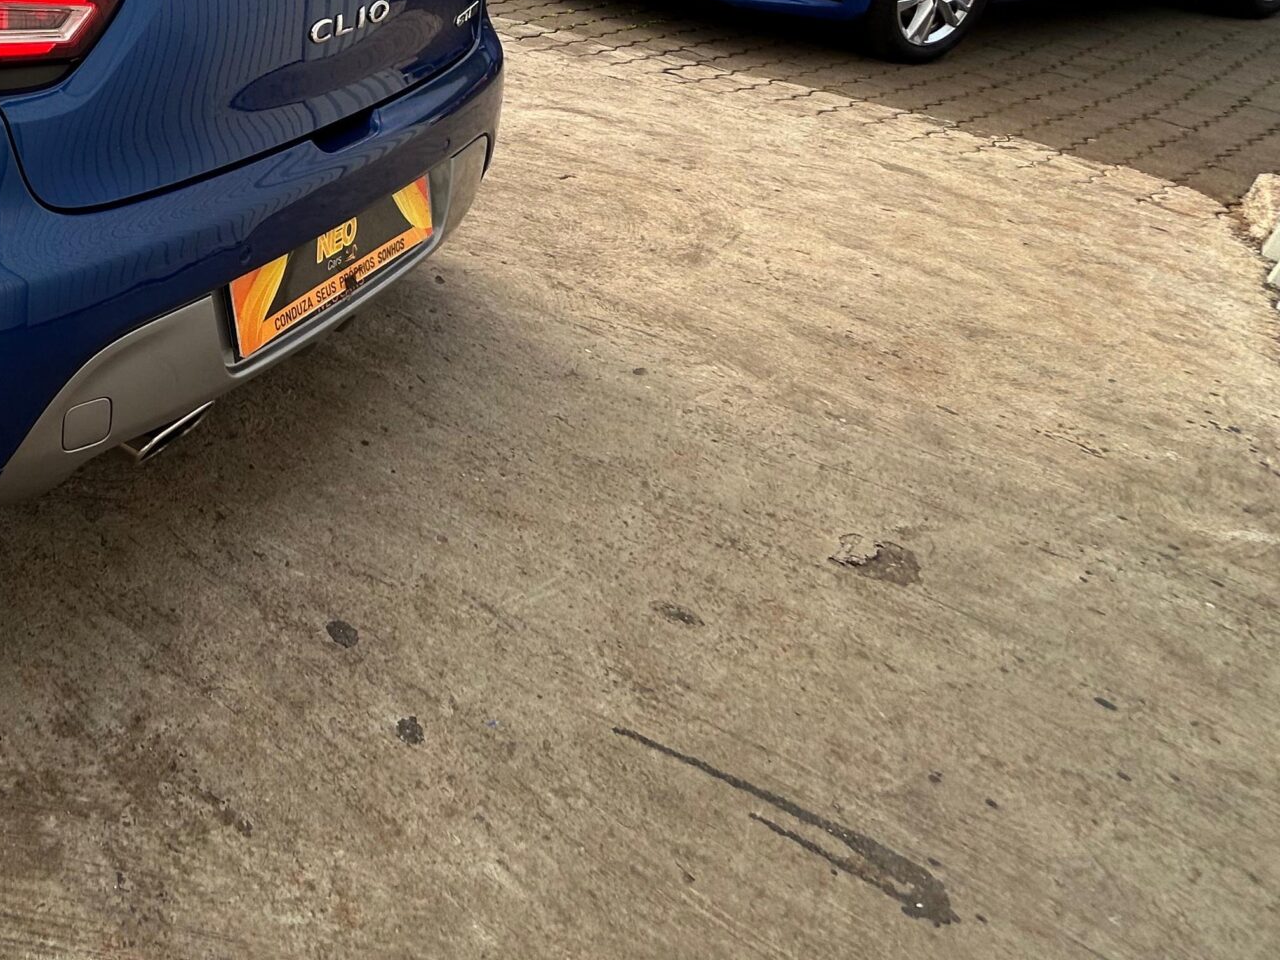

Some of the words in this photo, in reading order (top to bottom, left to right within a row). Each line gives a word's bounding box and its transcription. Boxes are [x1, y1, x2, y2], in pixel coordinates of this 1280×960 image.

[311, 0, 390, 43] CLIO
[316, 216, 358, 264] NEO
[274, 299, 314, 331] CONDUZA
[315, 281, 337, 303] SEUS
[377, 238, 405, 264] SONHOS
[327, 255, 342, 271] Cars
